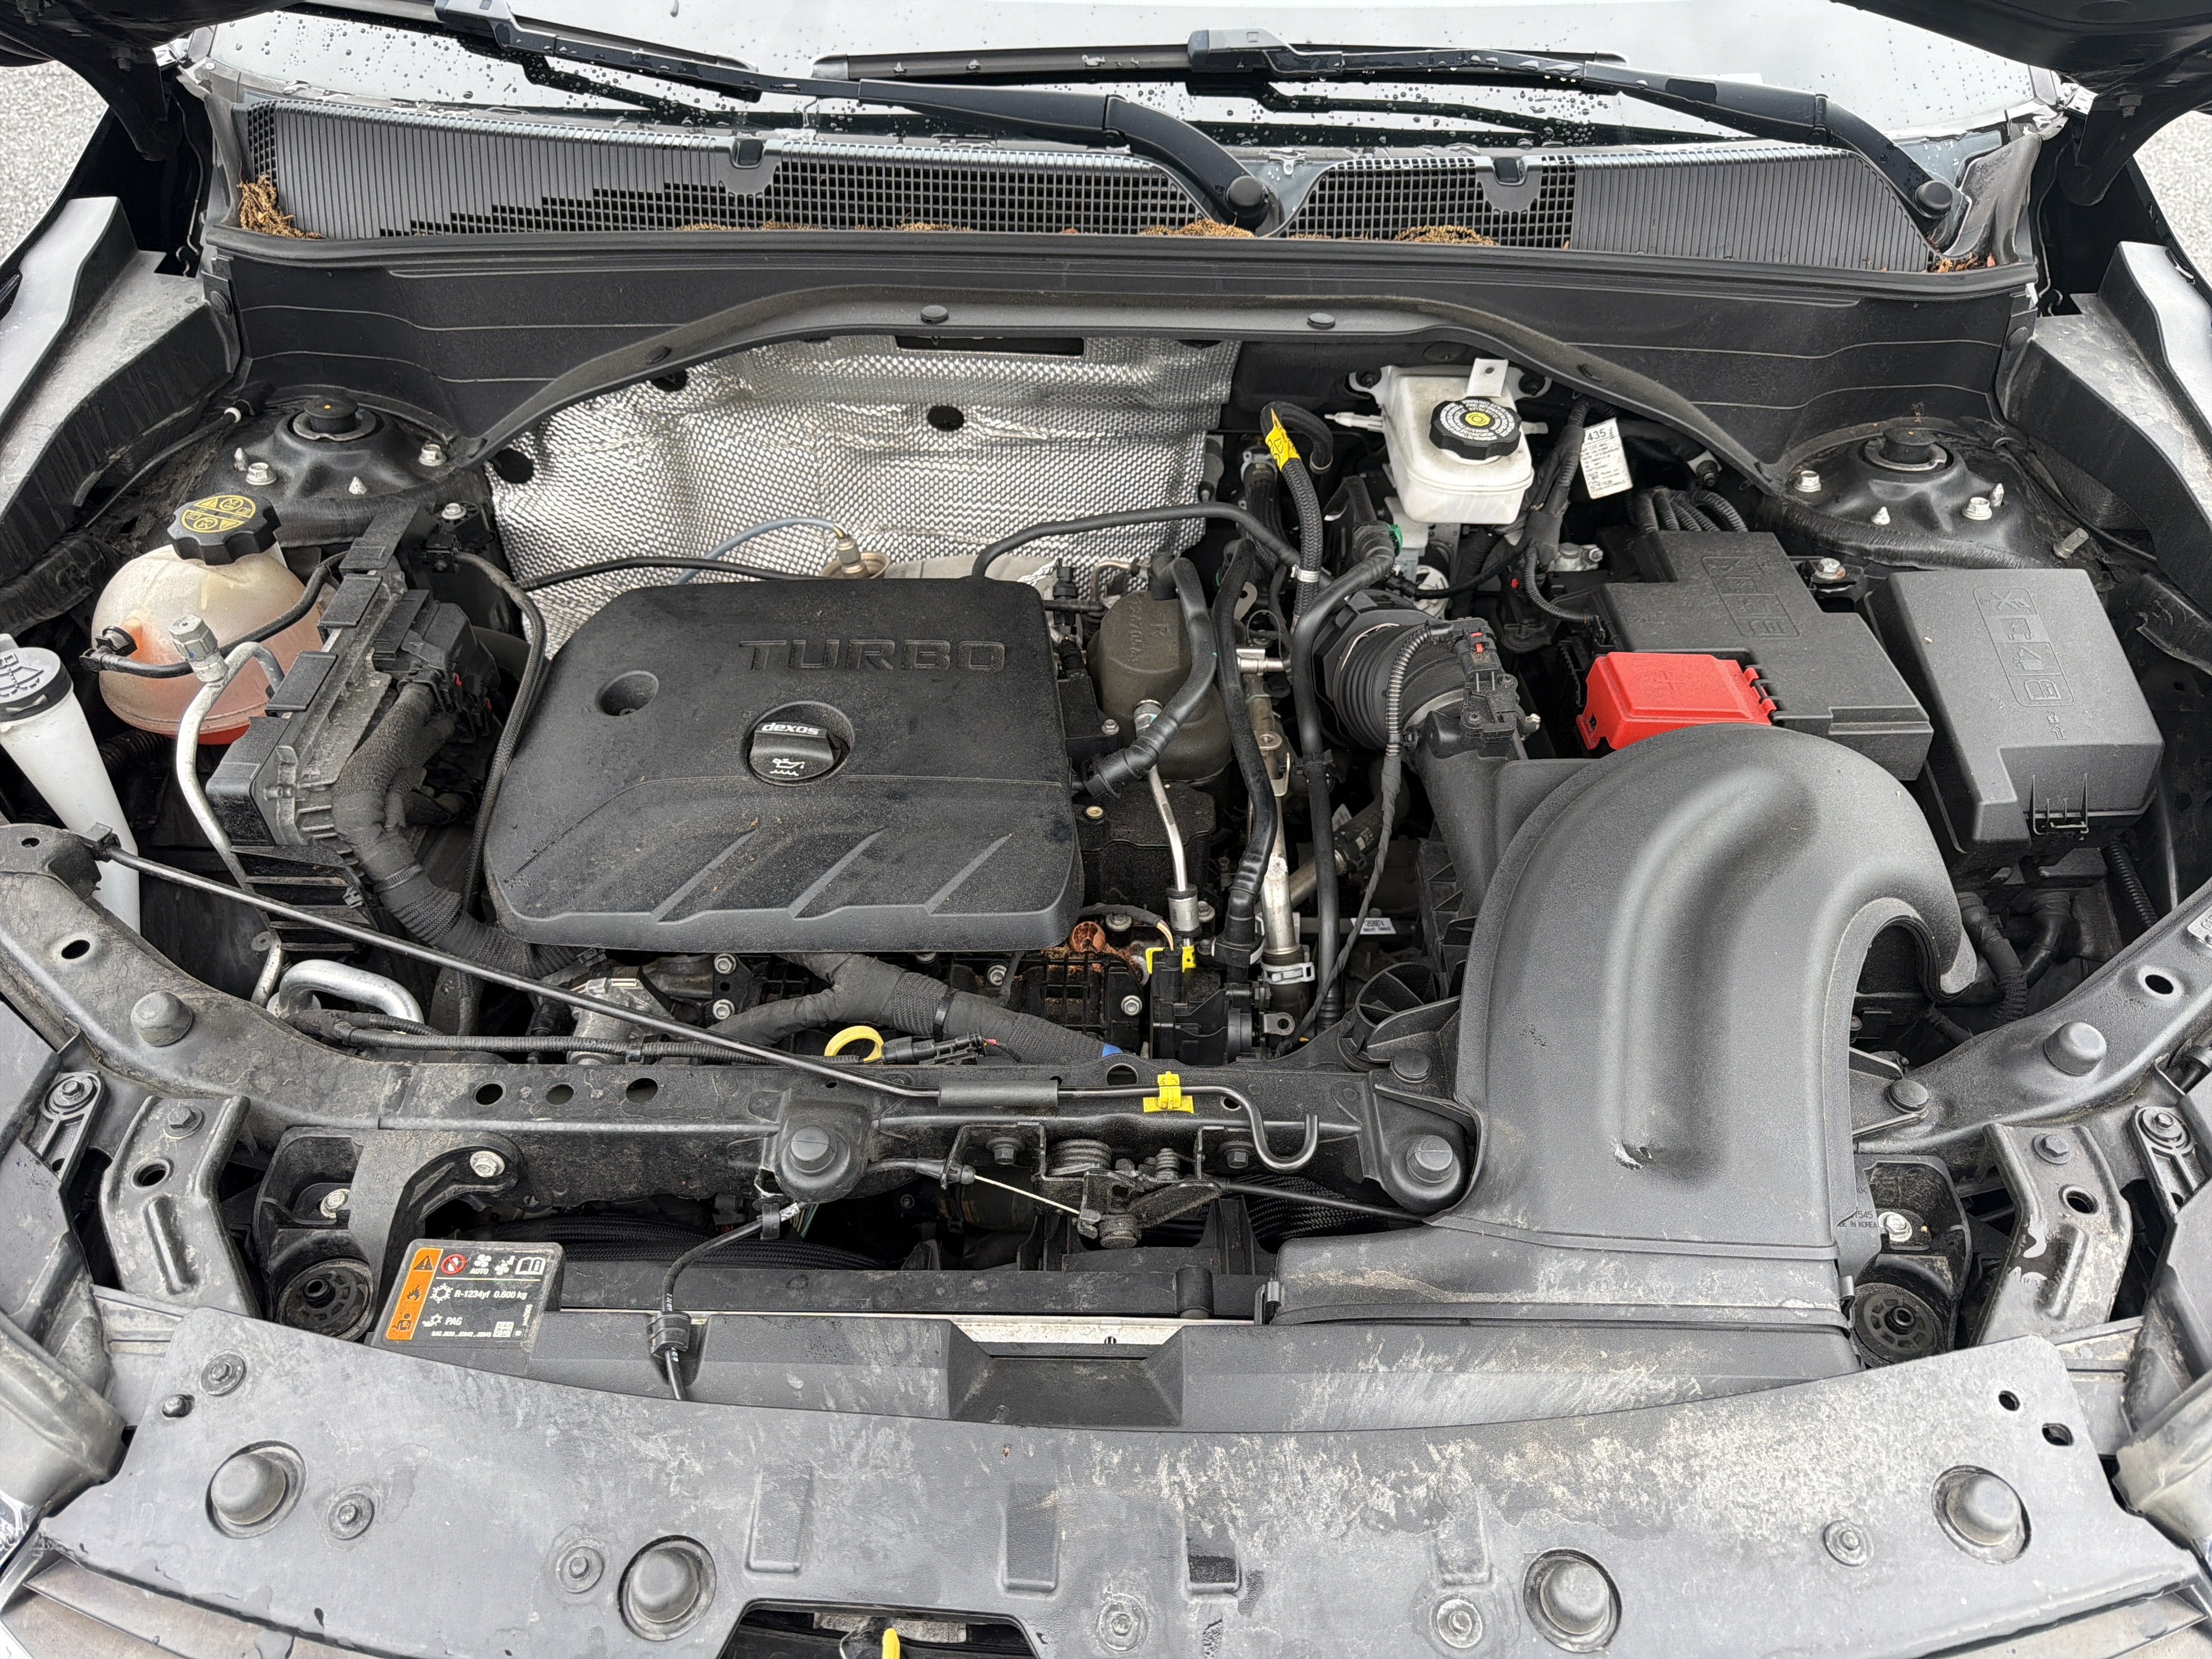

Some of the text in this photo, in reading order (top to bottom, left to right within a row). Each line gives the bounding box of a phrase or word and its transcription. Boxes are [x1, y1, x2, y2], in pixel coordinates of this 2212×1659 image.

[1587, 428, 1606, 441] 435
[738, 639, 1006, 672] TURBO
[761, 723, 820, 735] dexos
[454, 1290, 492, 1300] R-1234yf
[517, 1291, 528, 1300] kg
[445, 1317, 463, 1325] PAG
